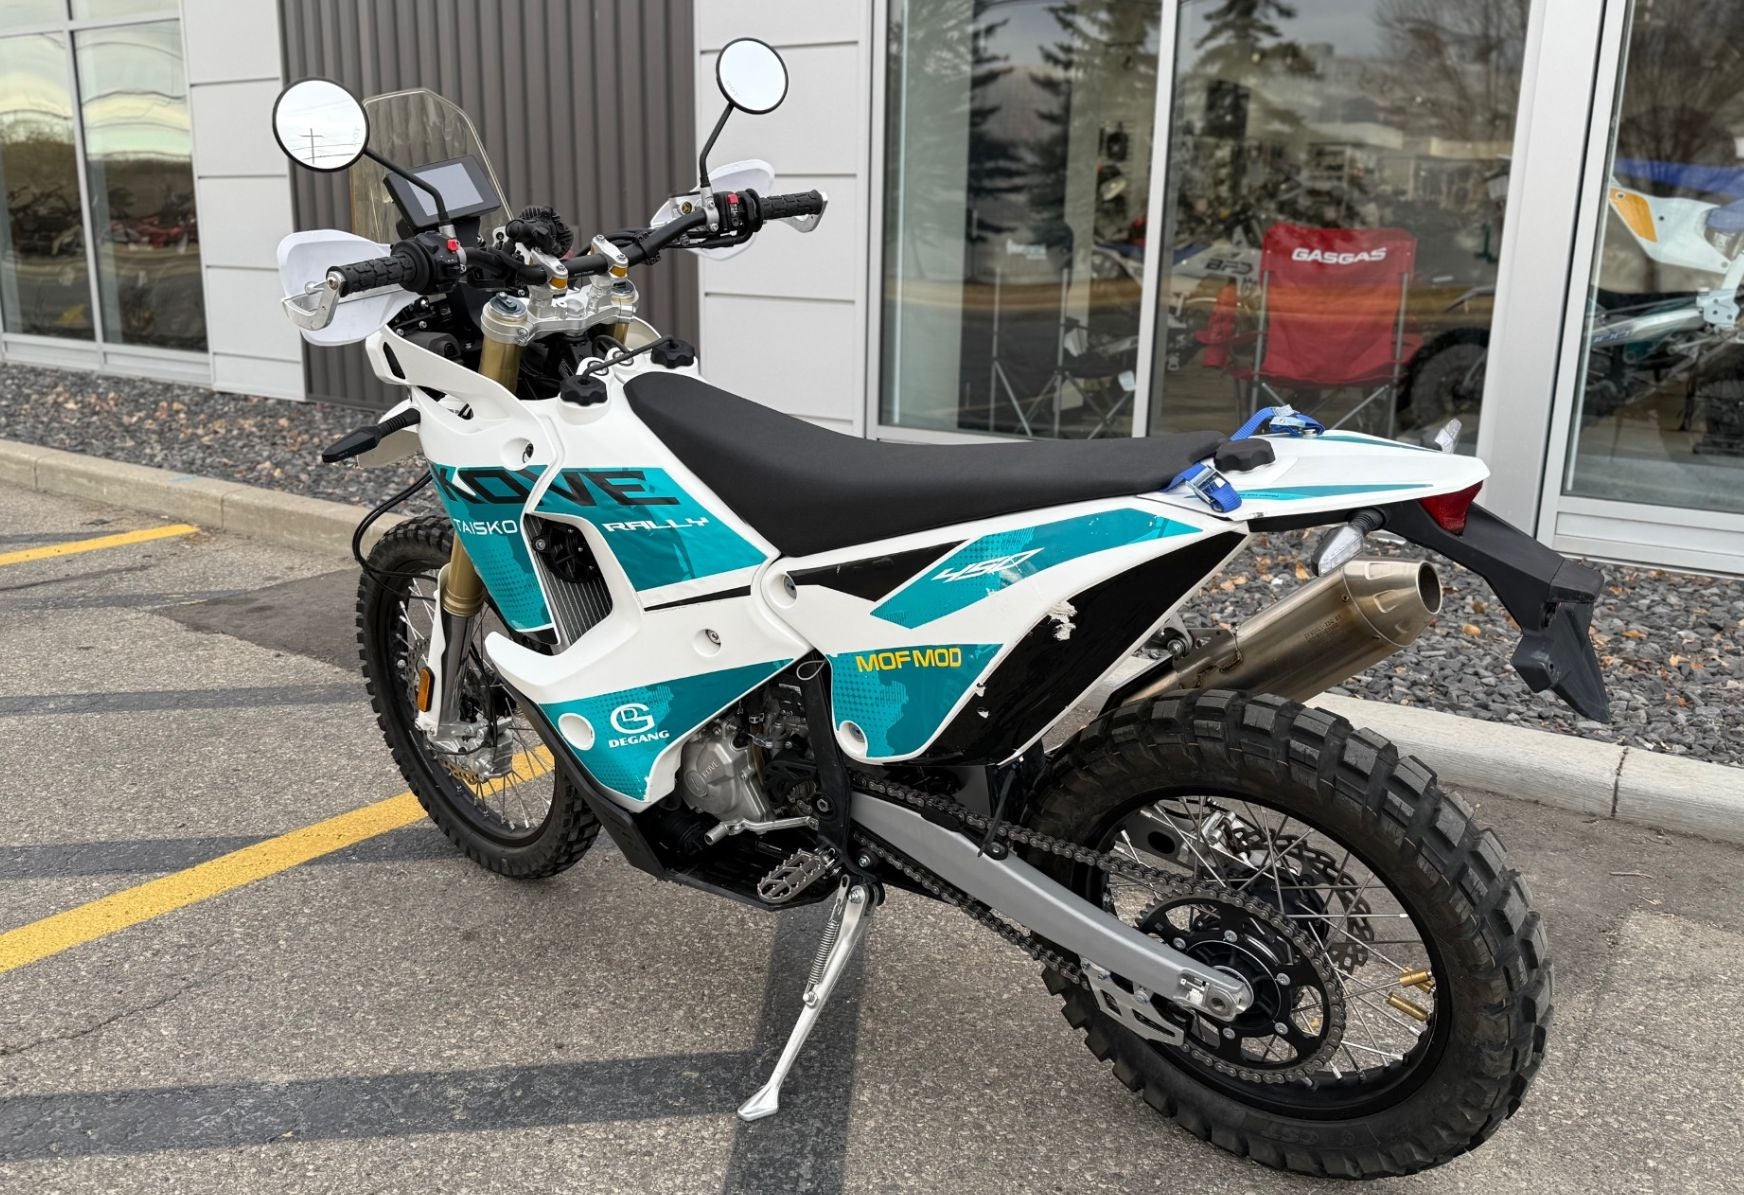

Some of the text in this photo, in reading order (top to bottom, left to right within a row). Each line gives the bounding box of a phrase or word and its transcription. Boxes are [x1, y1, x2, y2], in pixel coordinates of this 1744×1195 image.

[1292, 247, 1387, 264] GASGAS
[439, 467, 680, 506] KOVE
[453, 518, 518, 536] TAISKO
[602, 516, 709, 532] RALLY
[931, 546, 1046, 583] 450
[608, 729, 670, 748] DEGANG
